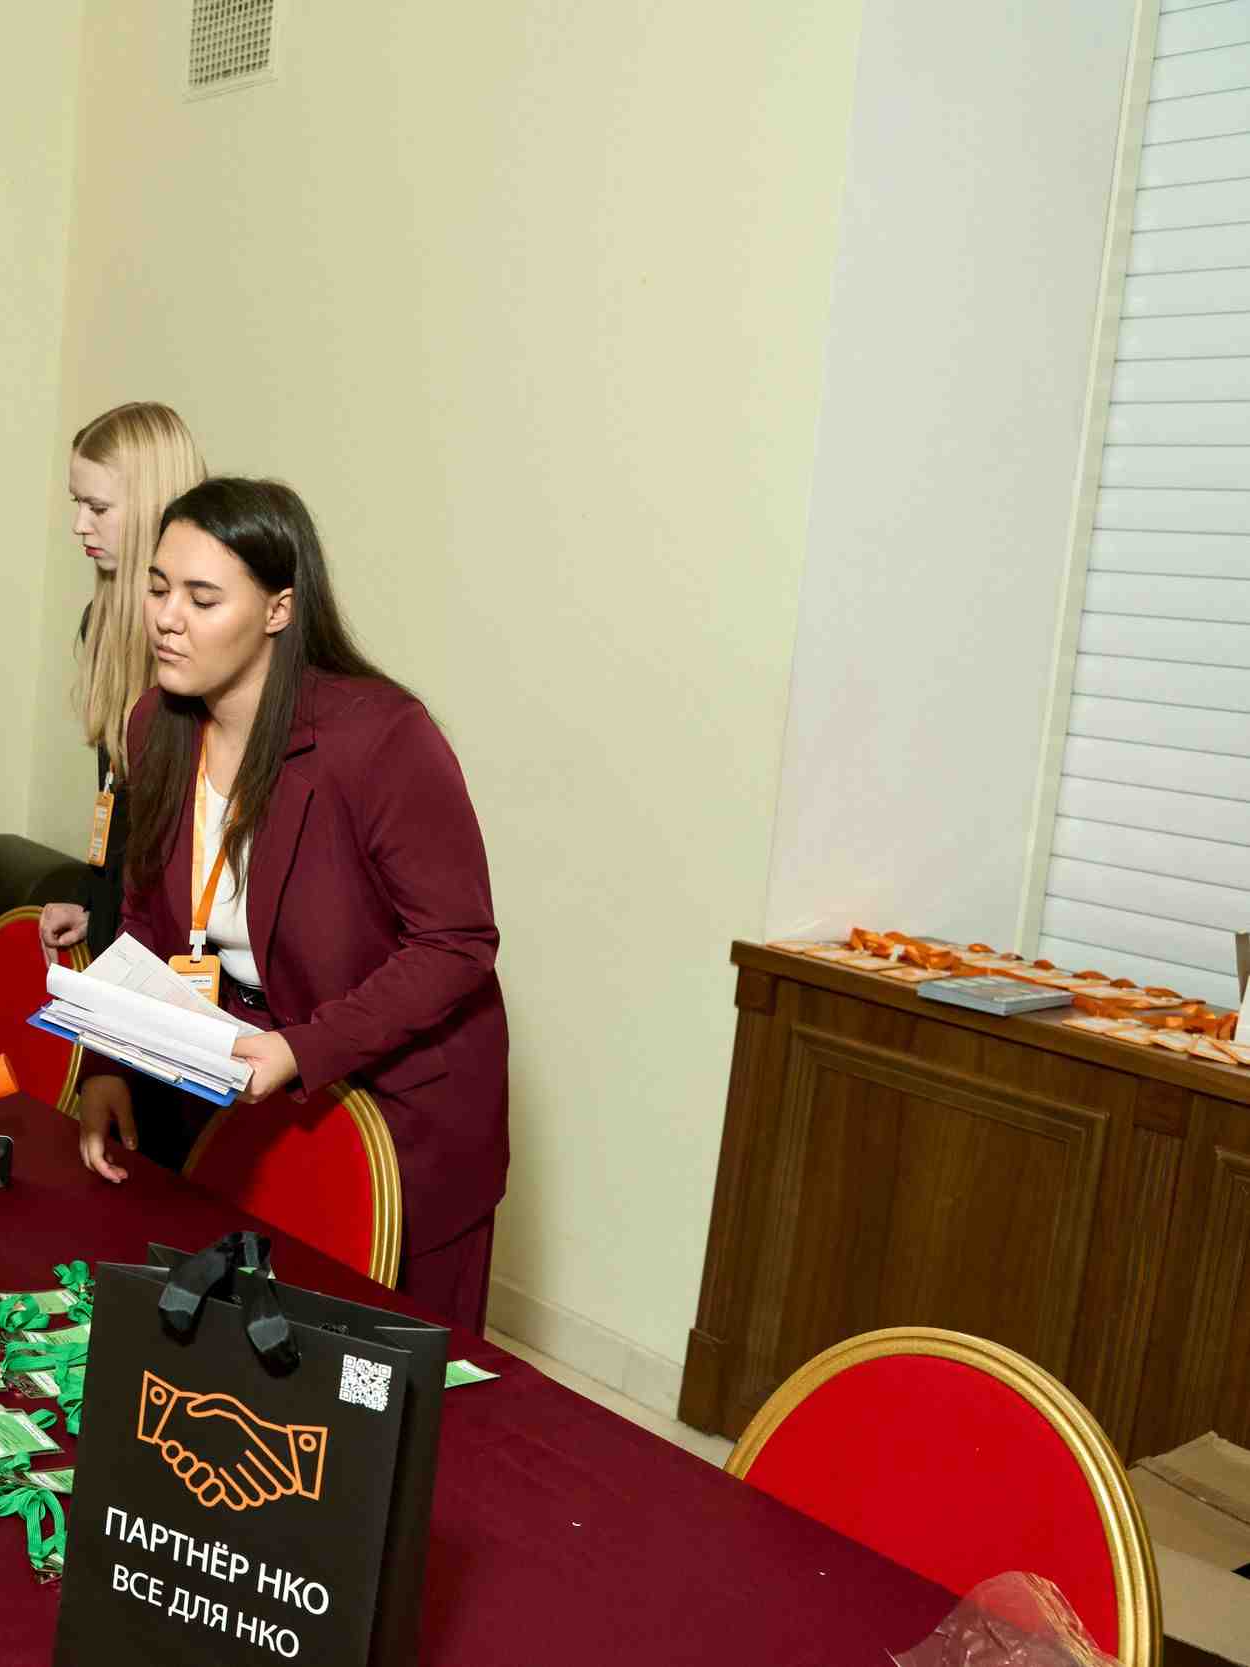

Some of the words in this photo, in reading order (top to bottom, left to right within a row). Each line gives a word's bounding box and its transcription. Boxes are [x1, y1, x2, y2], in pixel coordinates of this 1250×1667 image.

[105, 1506, 250, 1583] ПАРТНЁР
[256, 1562, 329, 1615] НКО
[112, 1563, 164, 1607] ВСЕ
[167, 1586, 229, 1633] ДЛЯ
[235, 1611, 300, 1658] НКО
